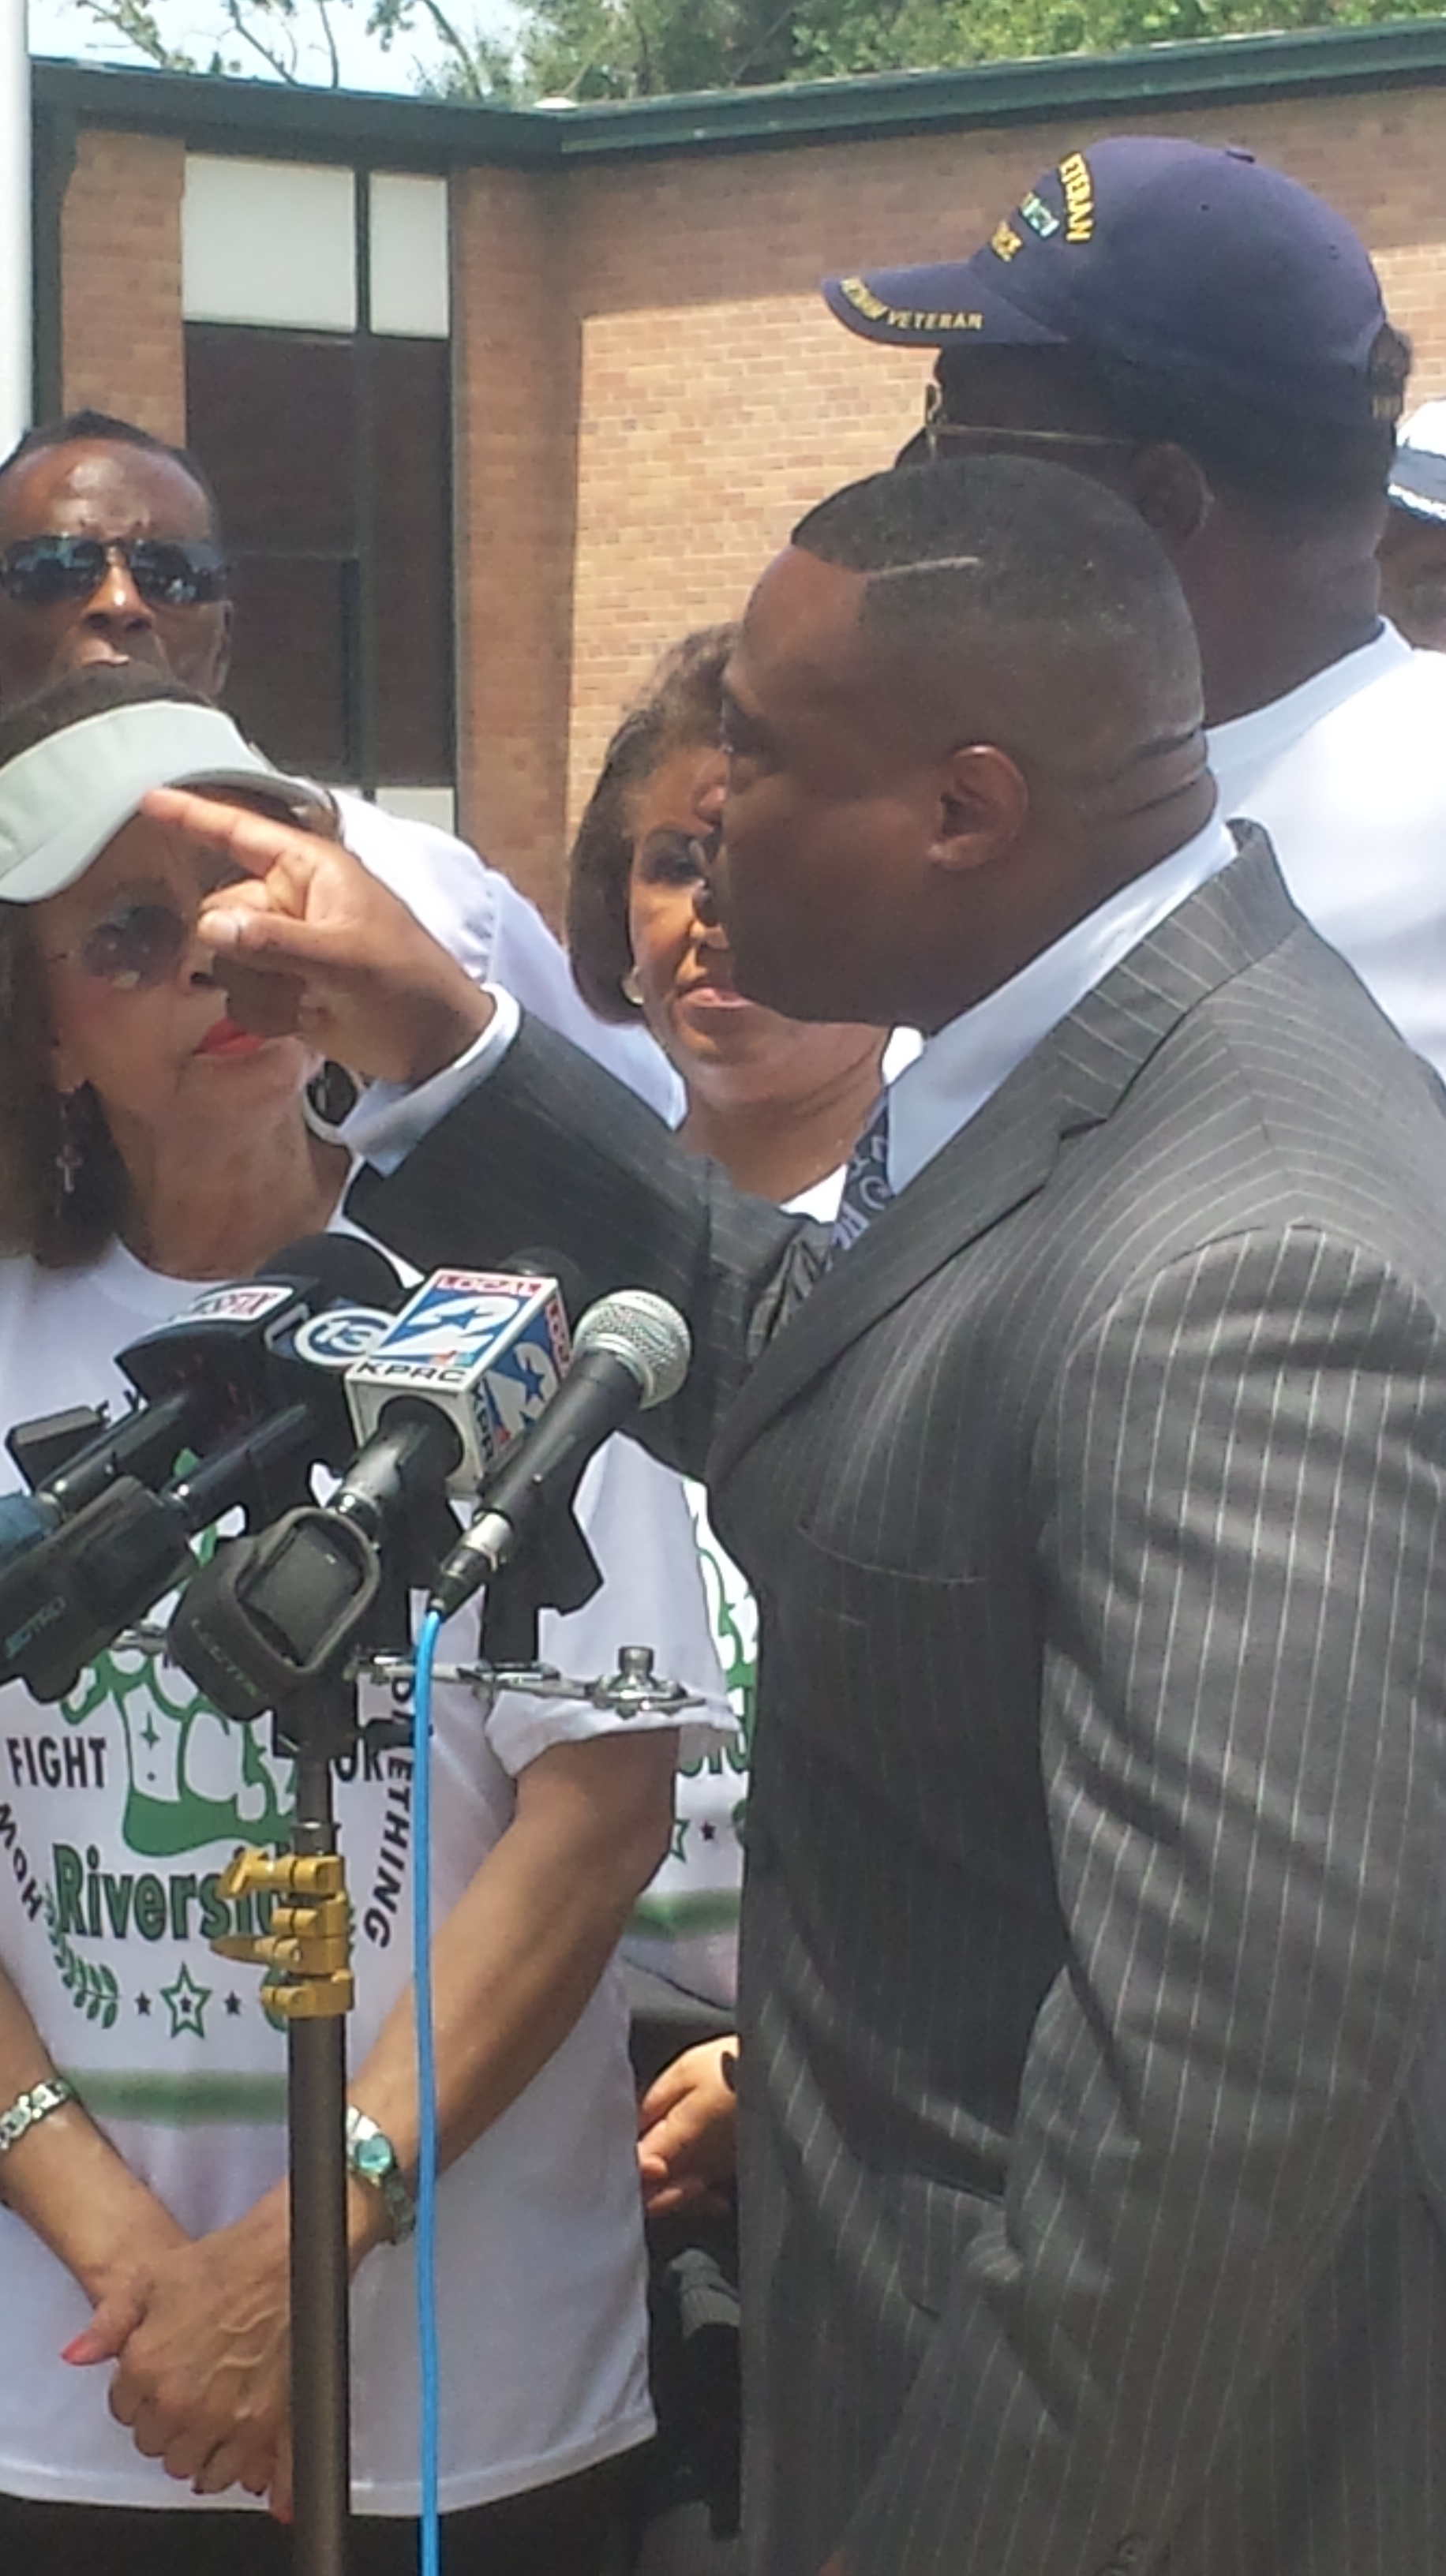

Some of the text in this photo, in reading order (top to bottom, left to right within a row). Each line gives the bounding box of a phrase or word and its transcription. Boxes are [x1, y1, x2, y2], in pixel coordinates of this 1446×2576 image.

[887, 310, 983, 331] VETERAN
[436, 1274, 545, 1297] LOCAL
[545, 1297, 572, 1379] LOCA
[357, 1361, 469, 1383] KPRC
[7, 1736, 107, 1789] FIGHT
